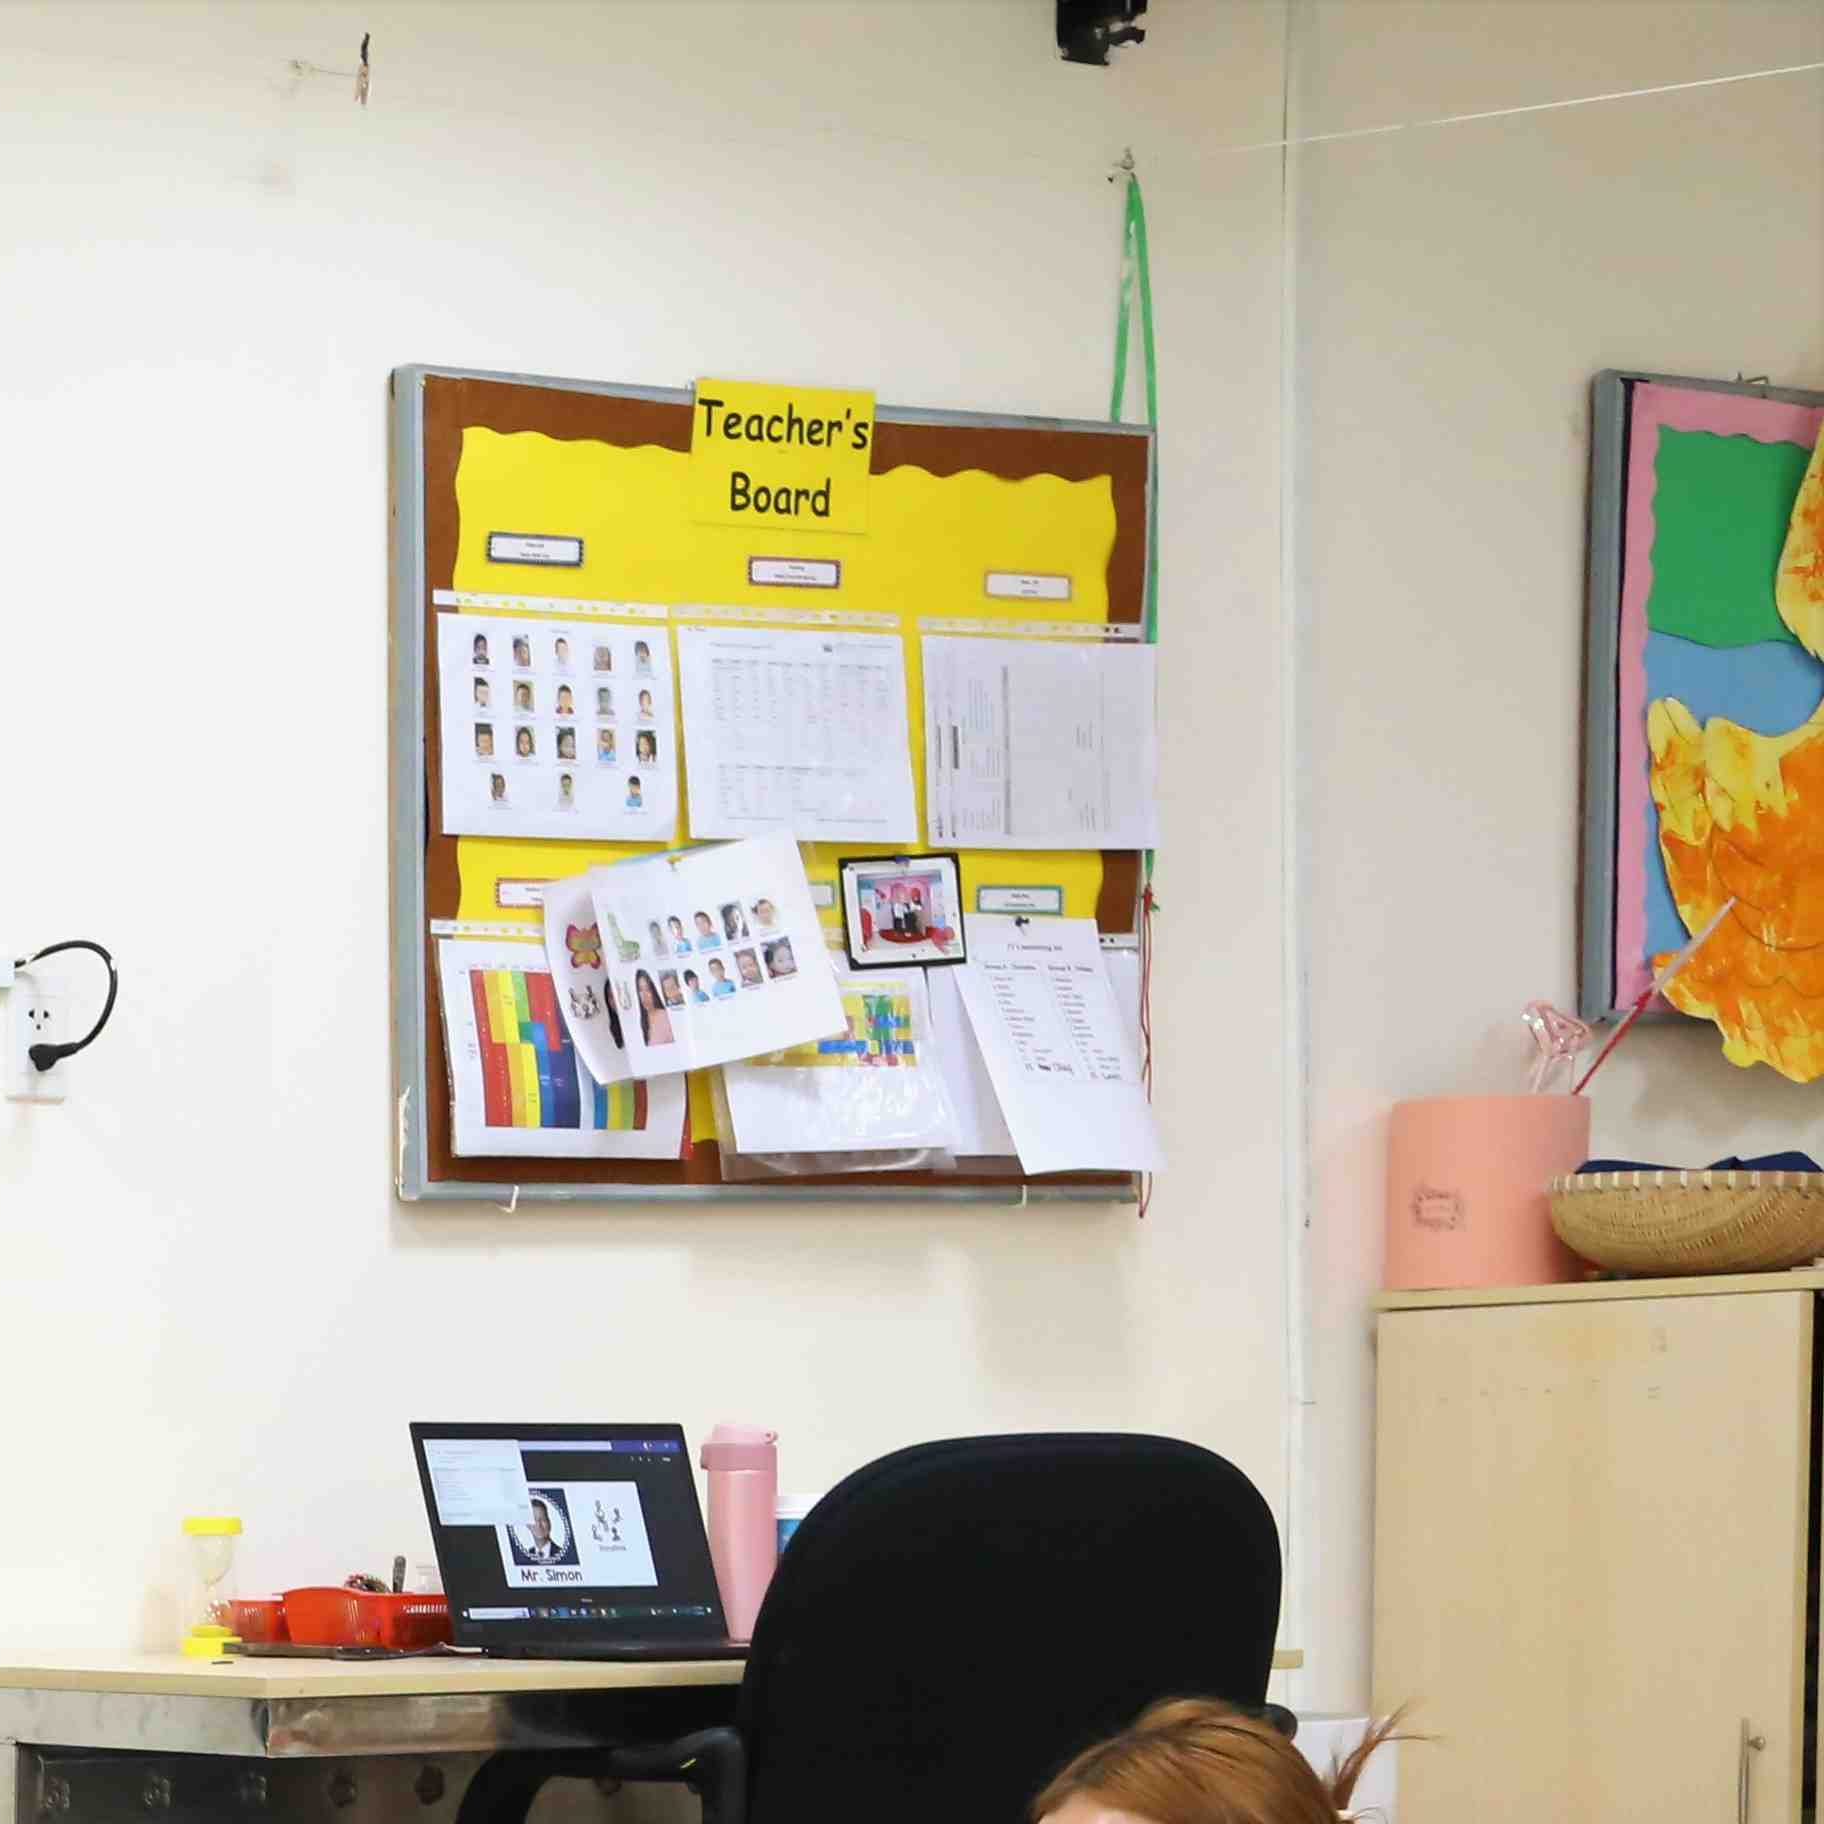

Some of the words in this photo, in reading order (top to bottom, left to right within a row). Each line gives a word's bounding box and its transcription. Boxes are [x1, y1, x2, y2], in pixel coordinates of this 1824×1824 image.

[697, 397, 870, 450] Teacher's
[730, 471, 832, 518] Board
[545, 1567, 584, 1582] Simon
